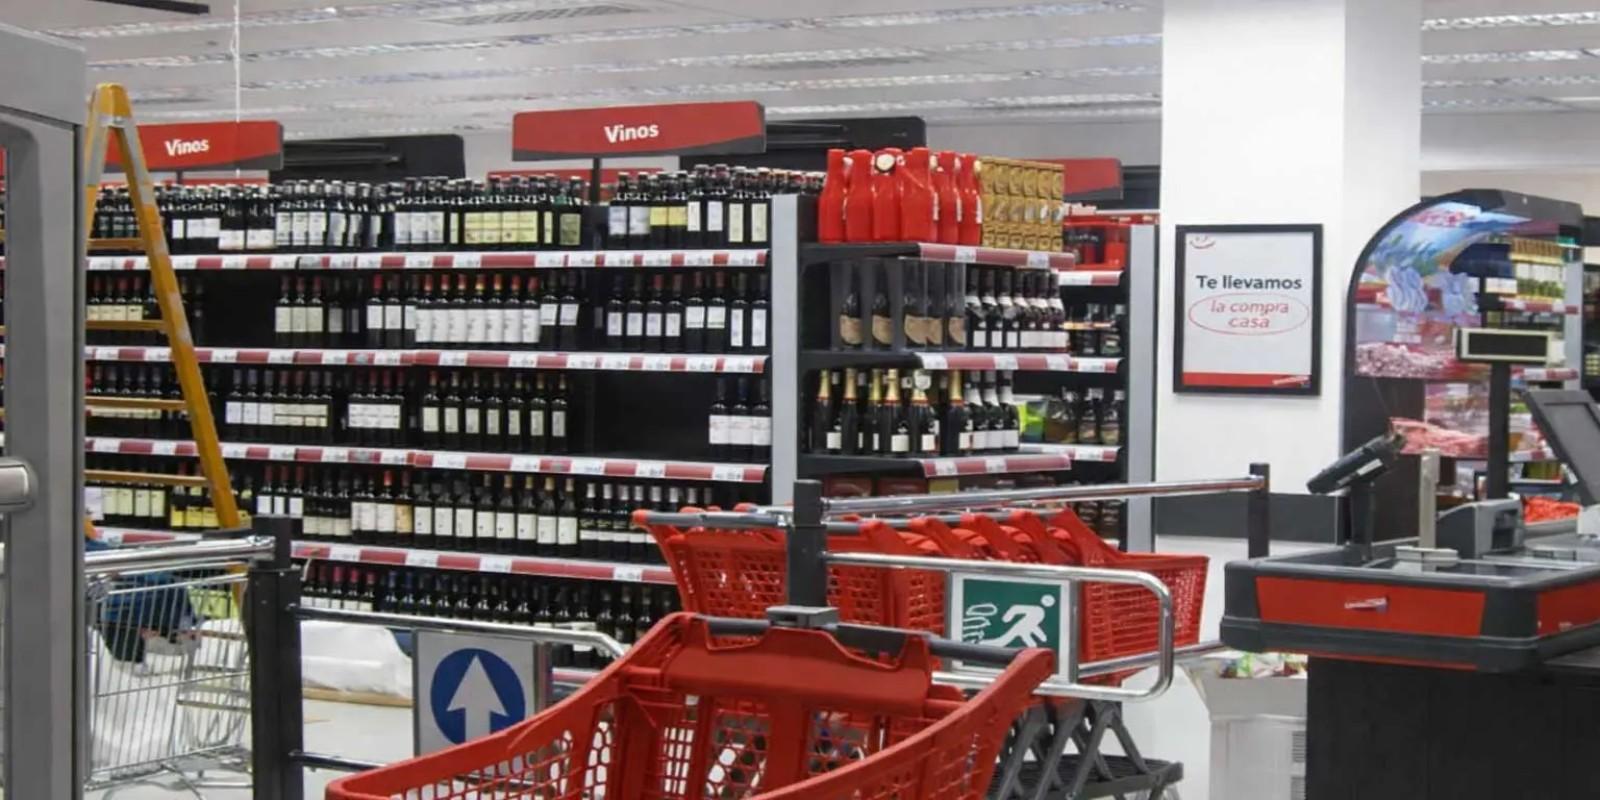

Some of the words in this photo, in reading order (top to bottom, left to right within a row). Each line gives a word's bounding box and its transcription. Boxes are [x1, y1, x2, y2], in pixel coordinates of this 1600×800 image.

[604, 124, 659, 143] Vinos
[164, 138, 209, 156] Vinos
[1196, 275, 1218, 289] Te
[1223, 275, 1302, 289] llevamos
[1210, 300, 1225, 313] la
[1230, 302, 1289, 316] compra
[1228, 317, 1270, 328] casa
